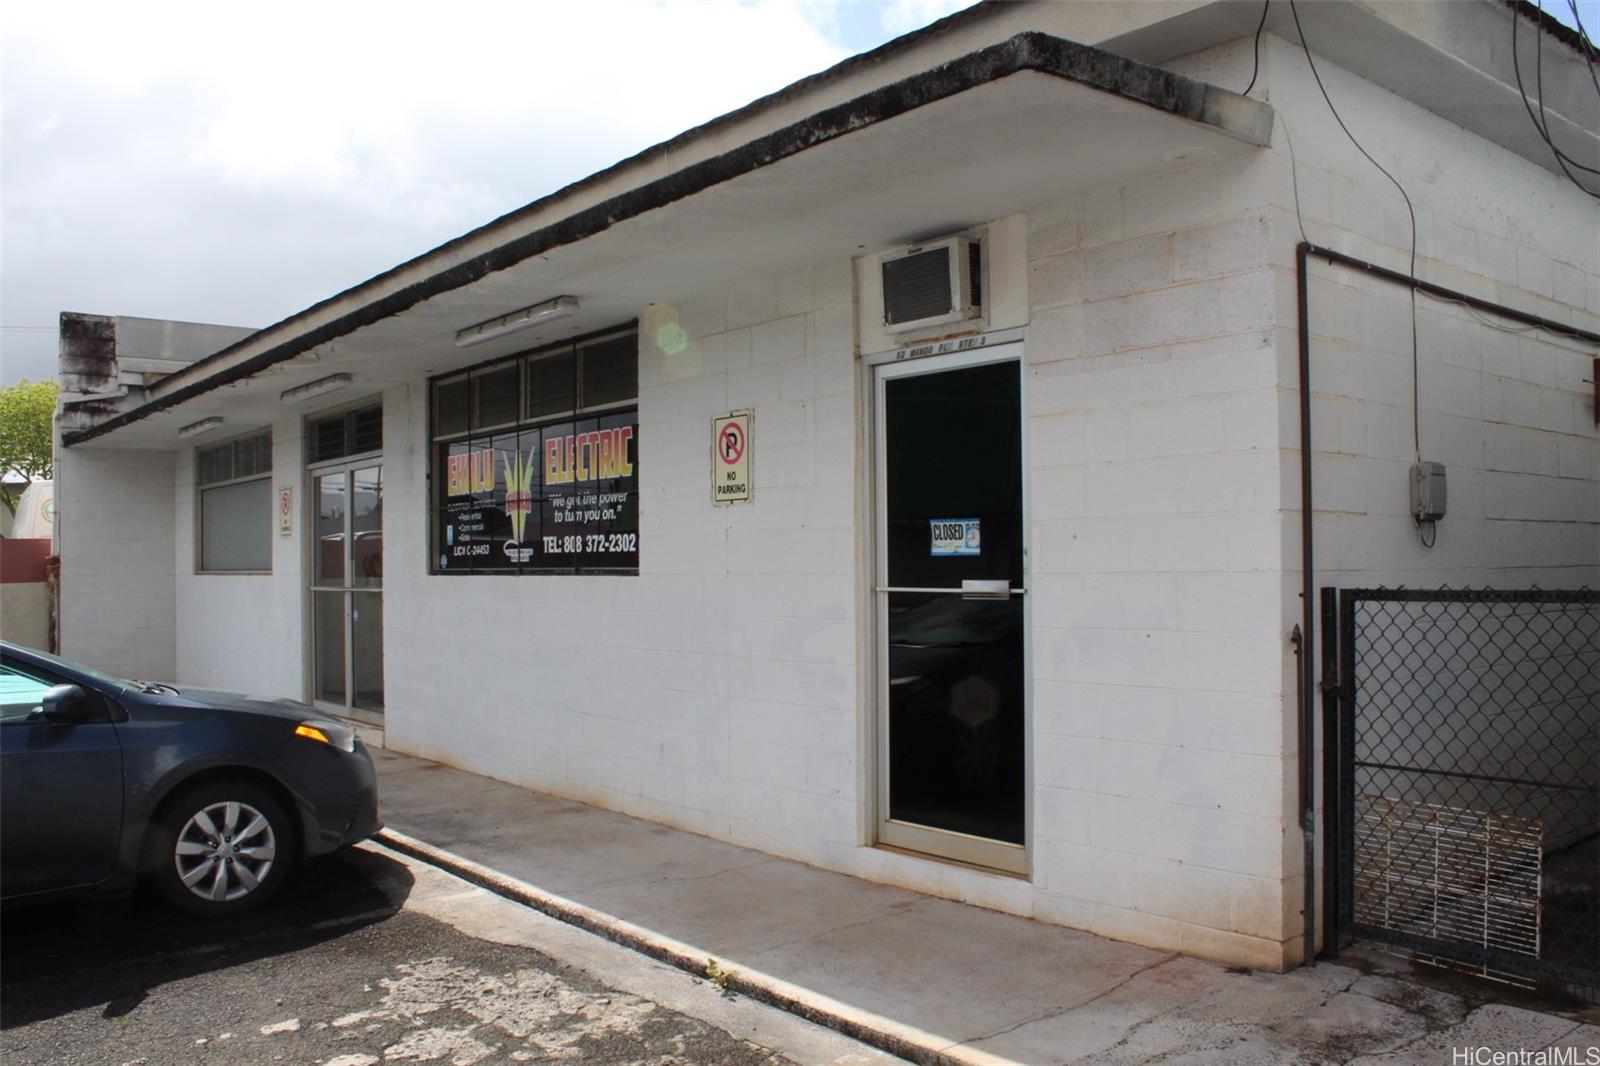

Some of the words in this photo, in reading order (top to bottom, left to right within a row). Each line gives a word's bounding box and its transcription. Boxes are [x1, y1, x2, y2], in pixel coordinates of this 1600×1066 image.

[546, 426, 633, 485] ELECTRIC
[727, 471, 736, 481] NO
[718, 484, 745, 495] PARKING
[584, 510, 600, 524] you
[933, 524, 963, 541] CLOSED
[543, 536, 561, 553] TEL:
[586, 534, 636, 552] 372-2302
